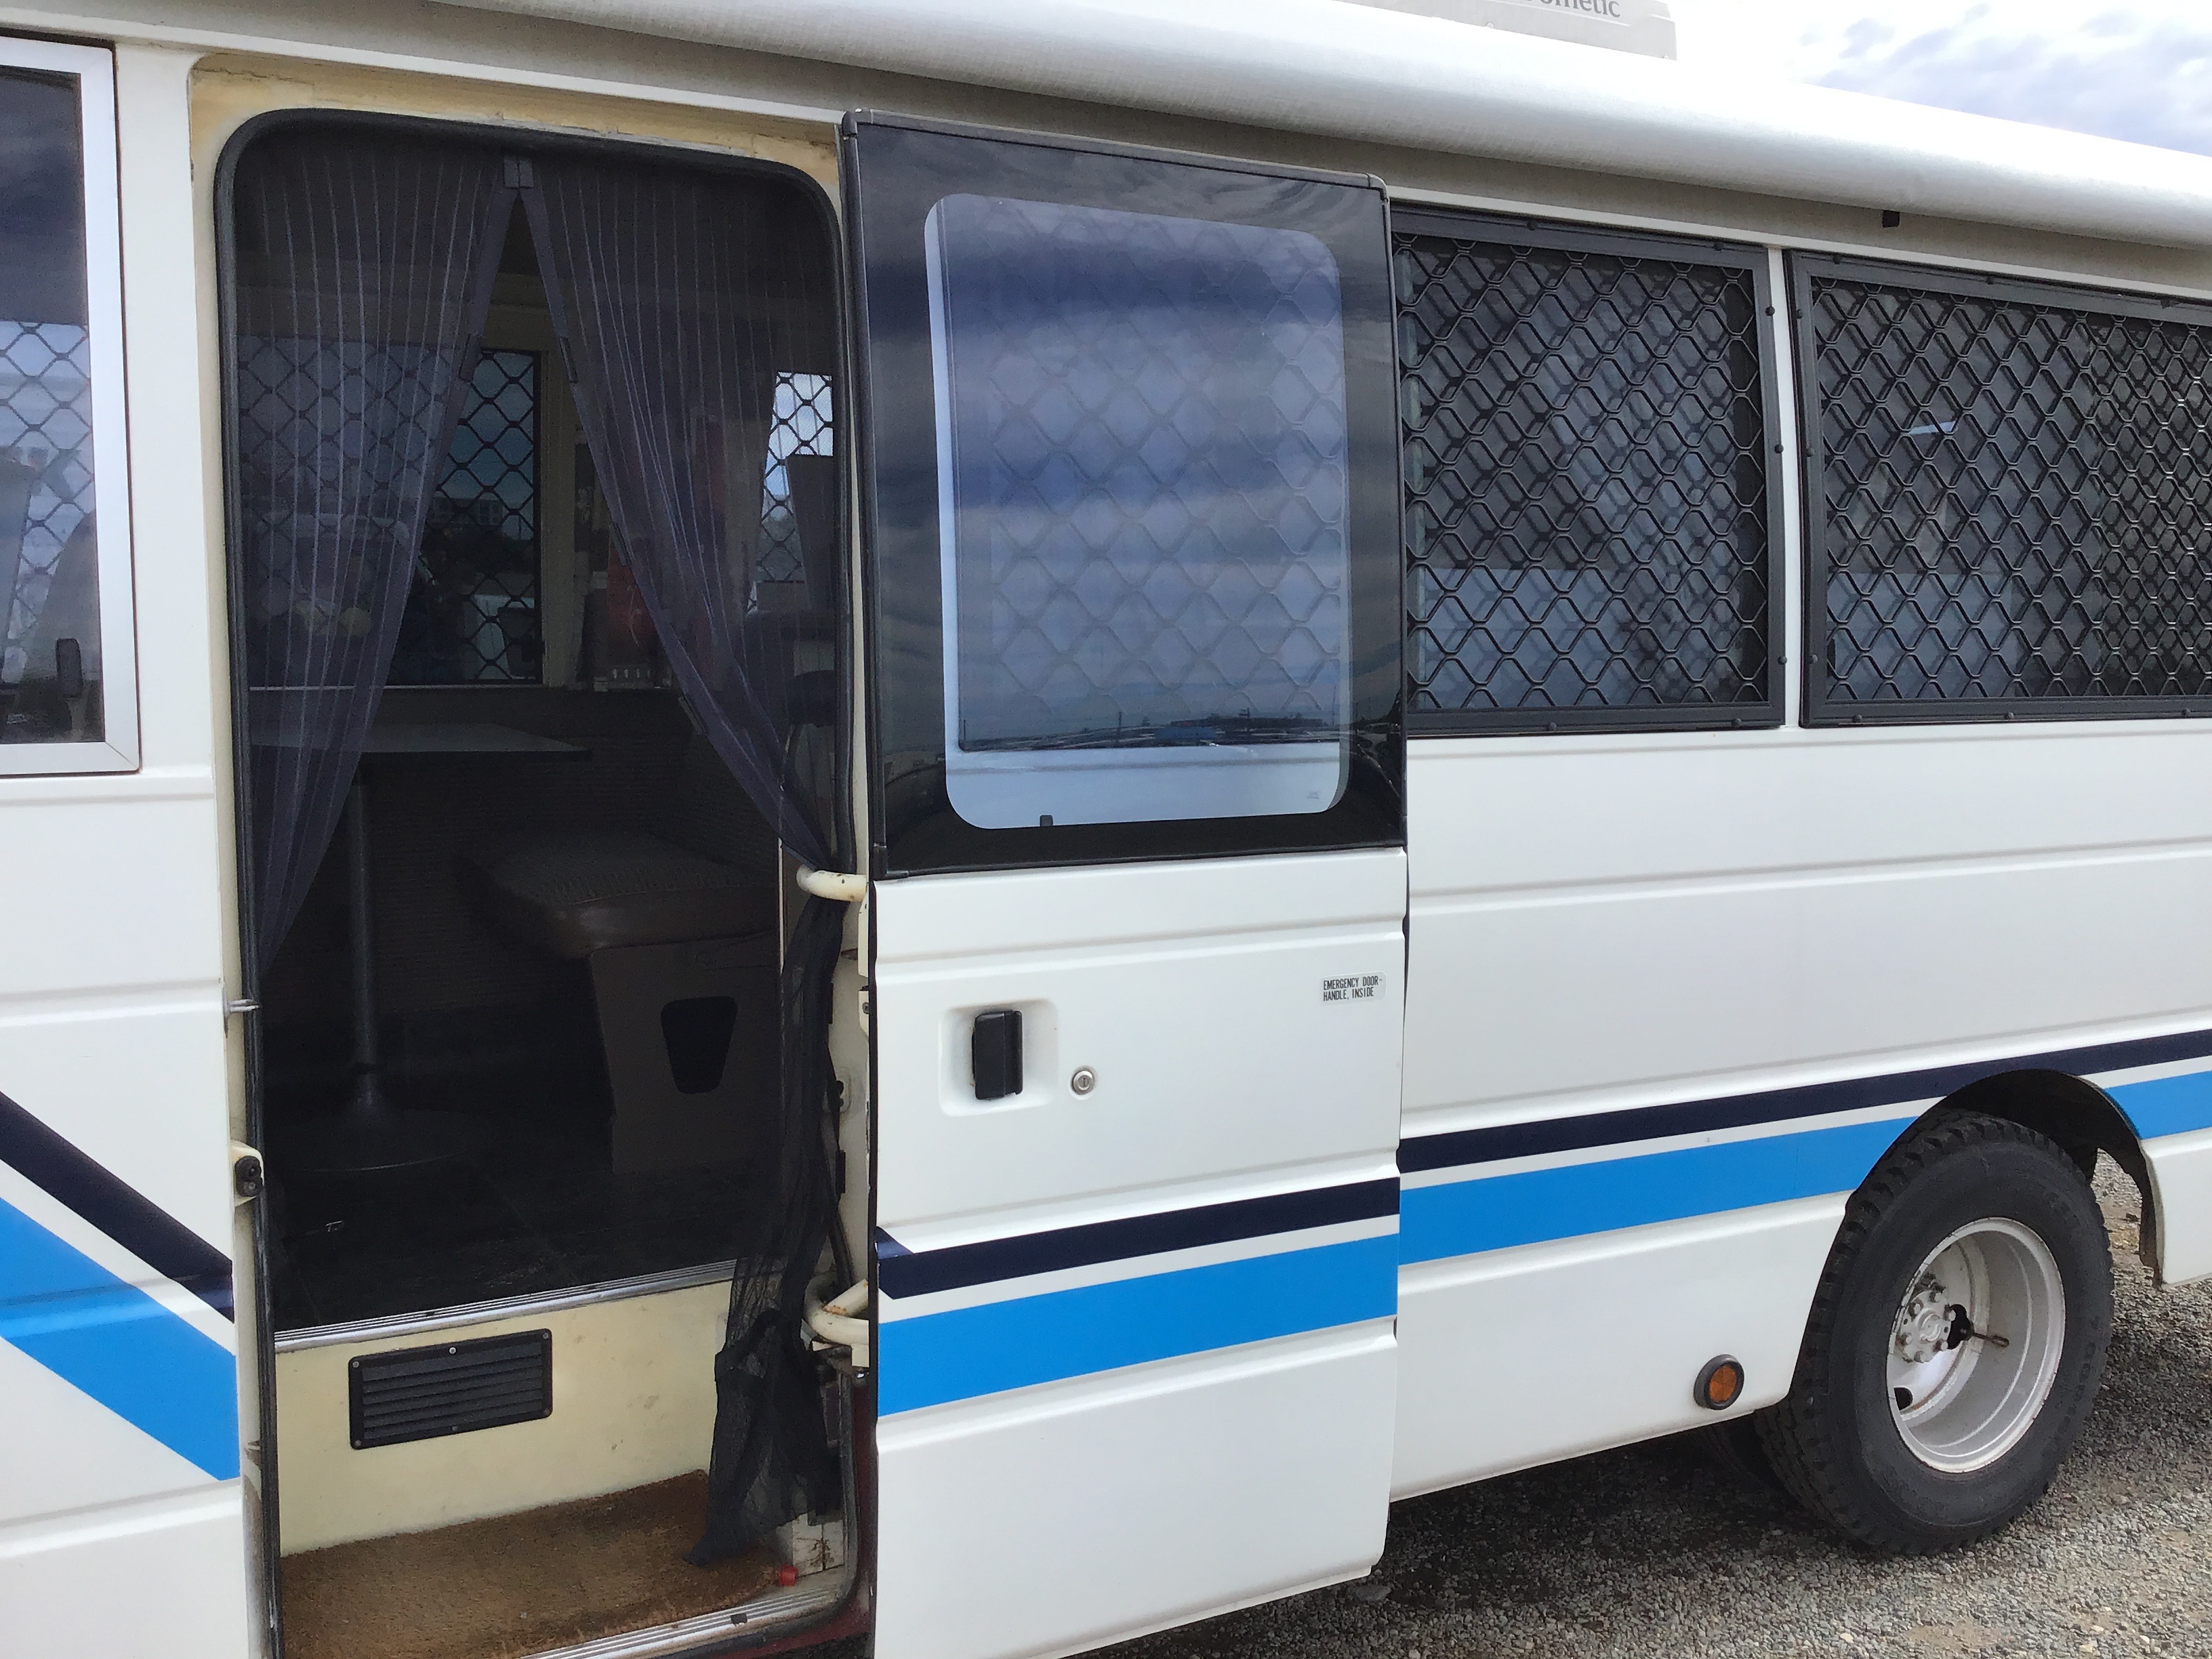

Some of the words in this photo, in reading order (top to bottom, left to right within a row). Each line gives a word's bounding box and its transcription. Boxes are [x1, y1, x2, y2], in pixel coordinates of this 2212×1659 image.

[1324, 977, 1359, 990] EMERGENCY
[1324, 989, 1349, 1001] HANDLE,
[1352, 987, 1374, 998] INSIDE
